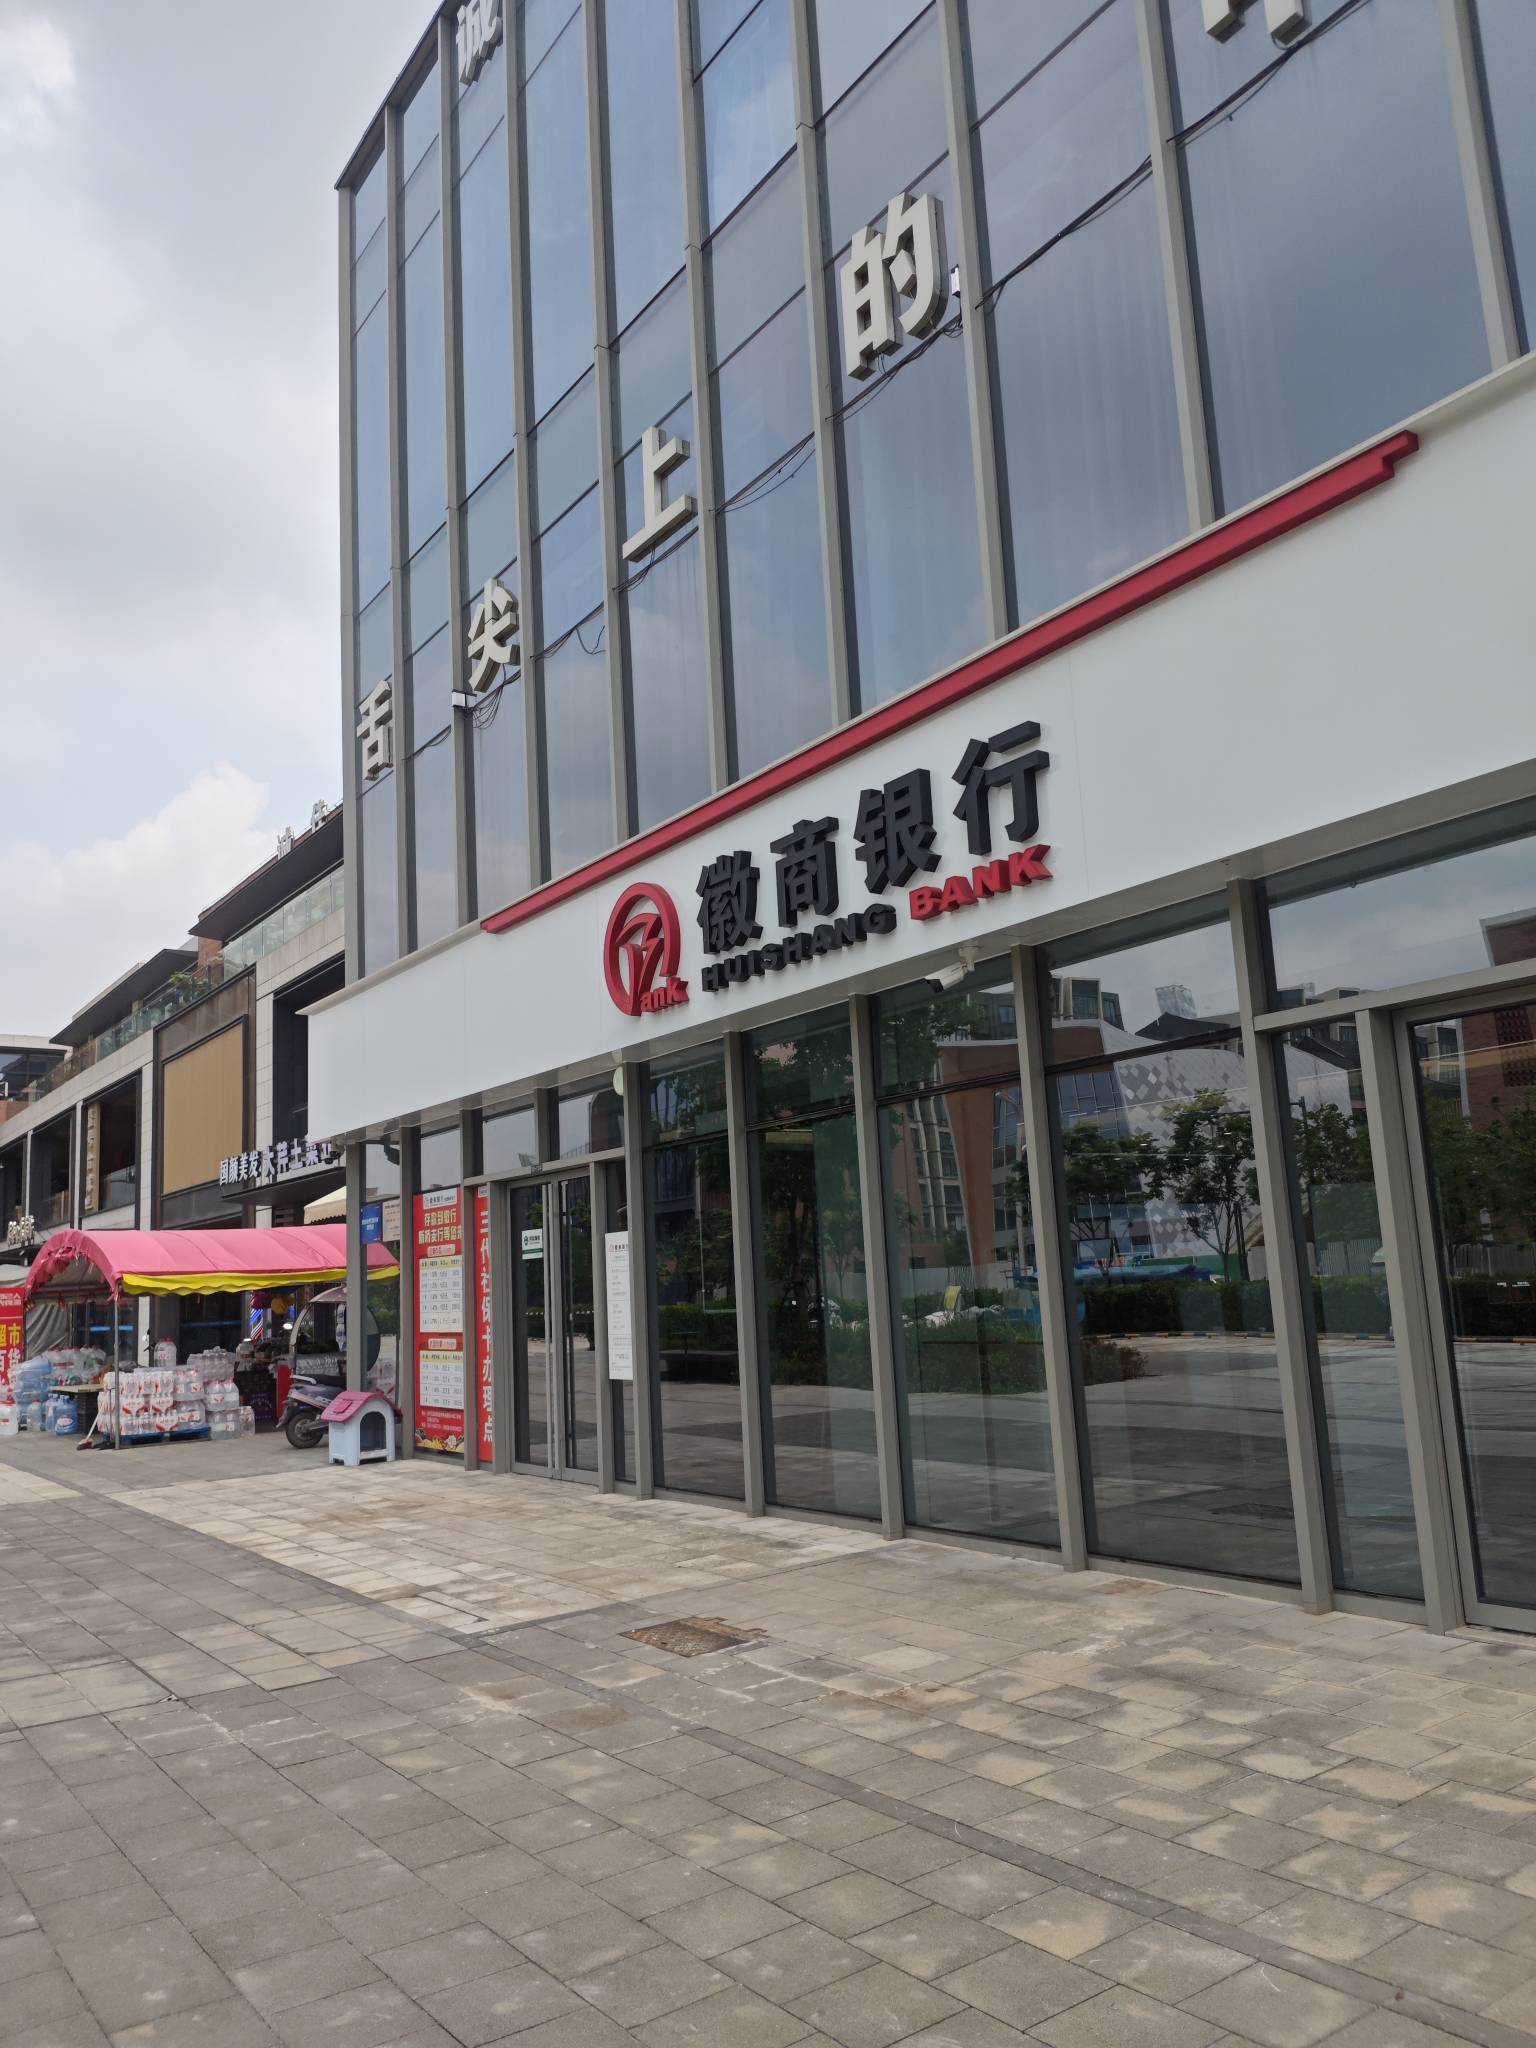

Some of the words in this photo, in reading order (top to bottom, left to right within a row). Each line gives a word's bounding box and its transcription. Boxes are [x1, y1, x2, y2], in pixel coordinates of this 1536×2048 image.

[695, 720, 1050, 955] 徽商银行
[701, 904, 897, 992] HUISHANG
[909, 844, 1053, 921] BANK
